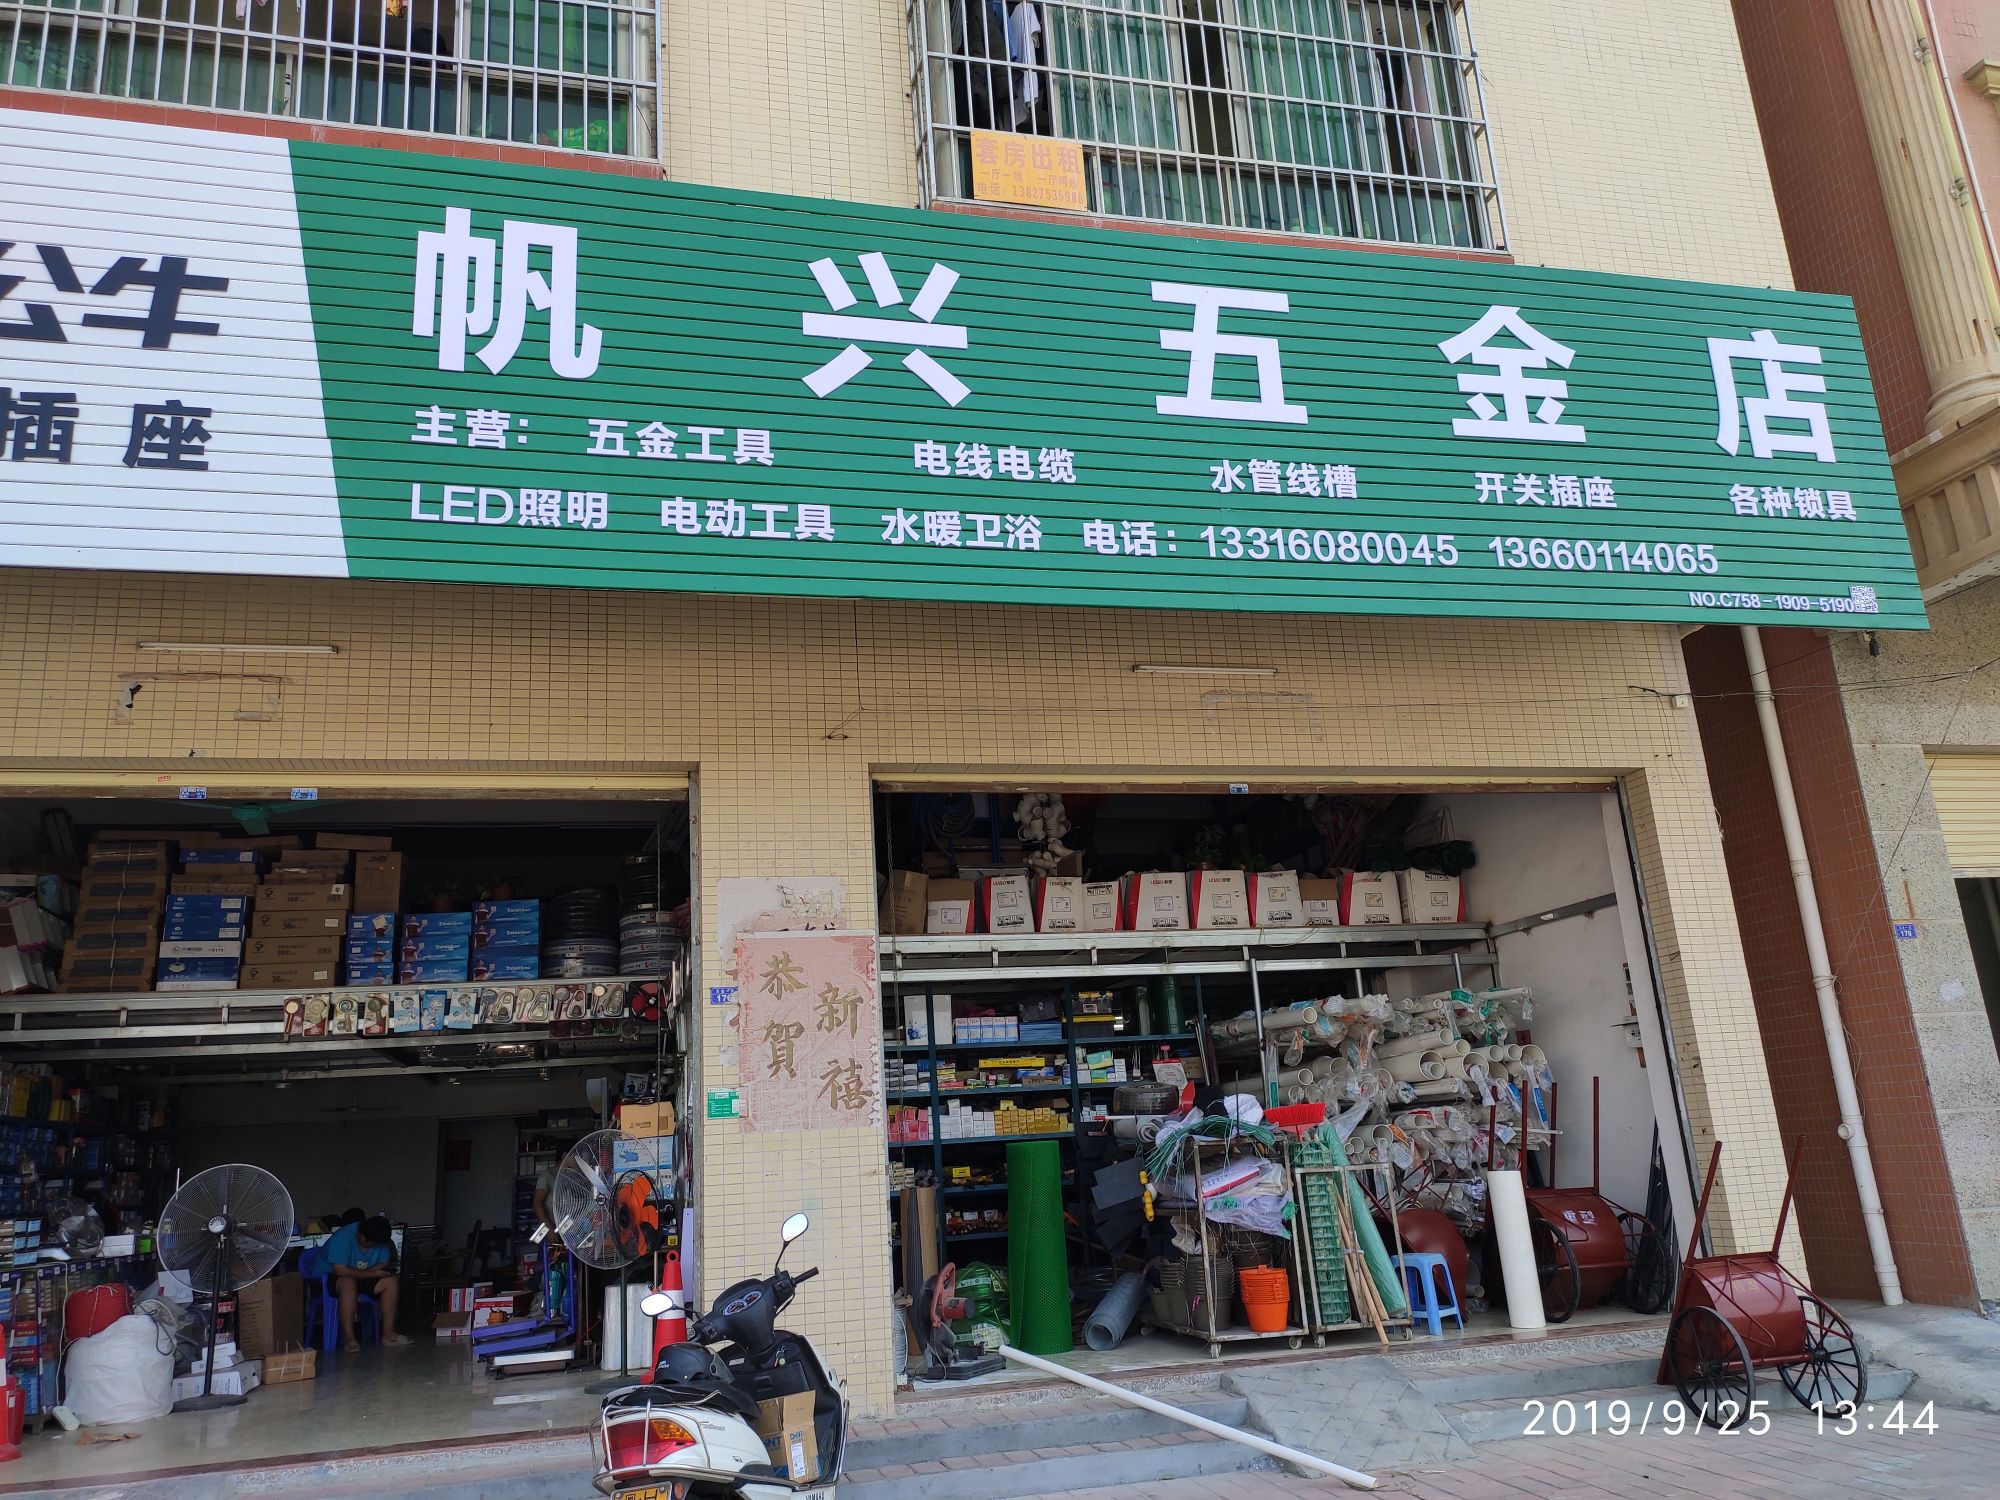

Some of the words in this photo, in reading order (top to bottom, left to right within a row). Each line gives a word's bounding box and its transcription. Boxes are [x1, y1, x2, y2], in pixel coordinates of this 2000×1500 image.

[976, 137, 1080, 174] 套房出租
[412, 206, 1836, 463] 帆兴五金店
[586, 418, 775, 466] 五金工具
[914, 439, 1077, 484] 电线电缆
[1210, 458, 1358, 499] 水管线槽
[1474, 472, 1618, 509] 开关插座
[1729, 483, 1857, 522] 各种锁具
[411, 483, 608, 530] LED照明
[660, 496, 836, 542] 电动工具
[881, 507, 1043, 551] 水暖卫浴
[1488, 536, 1719, 574] 13660114065
